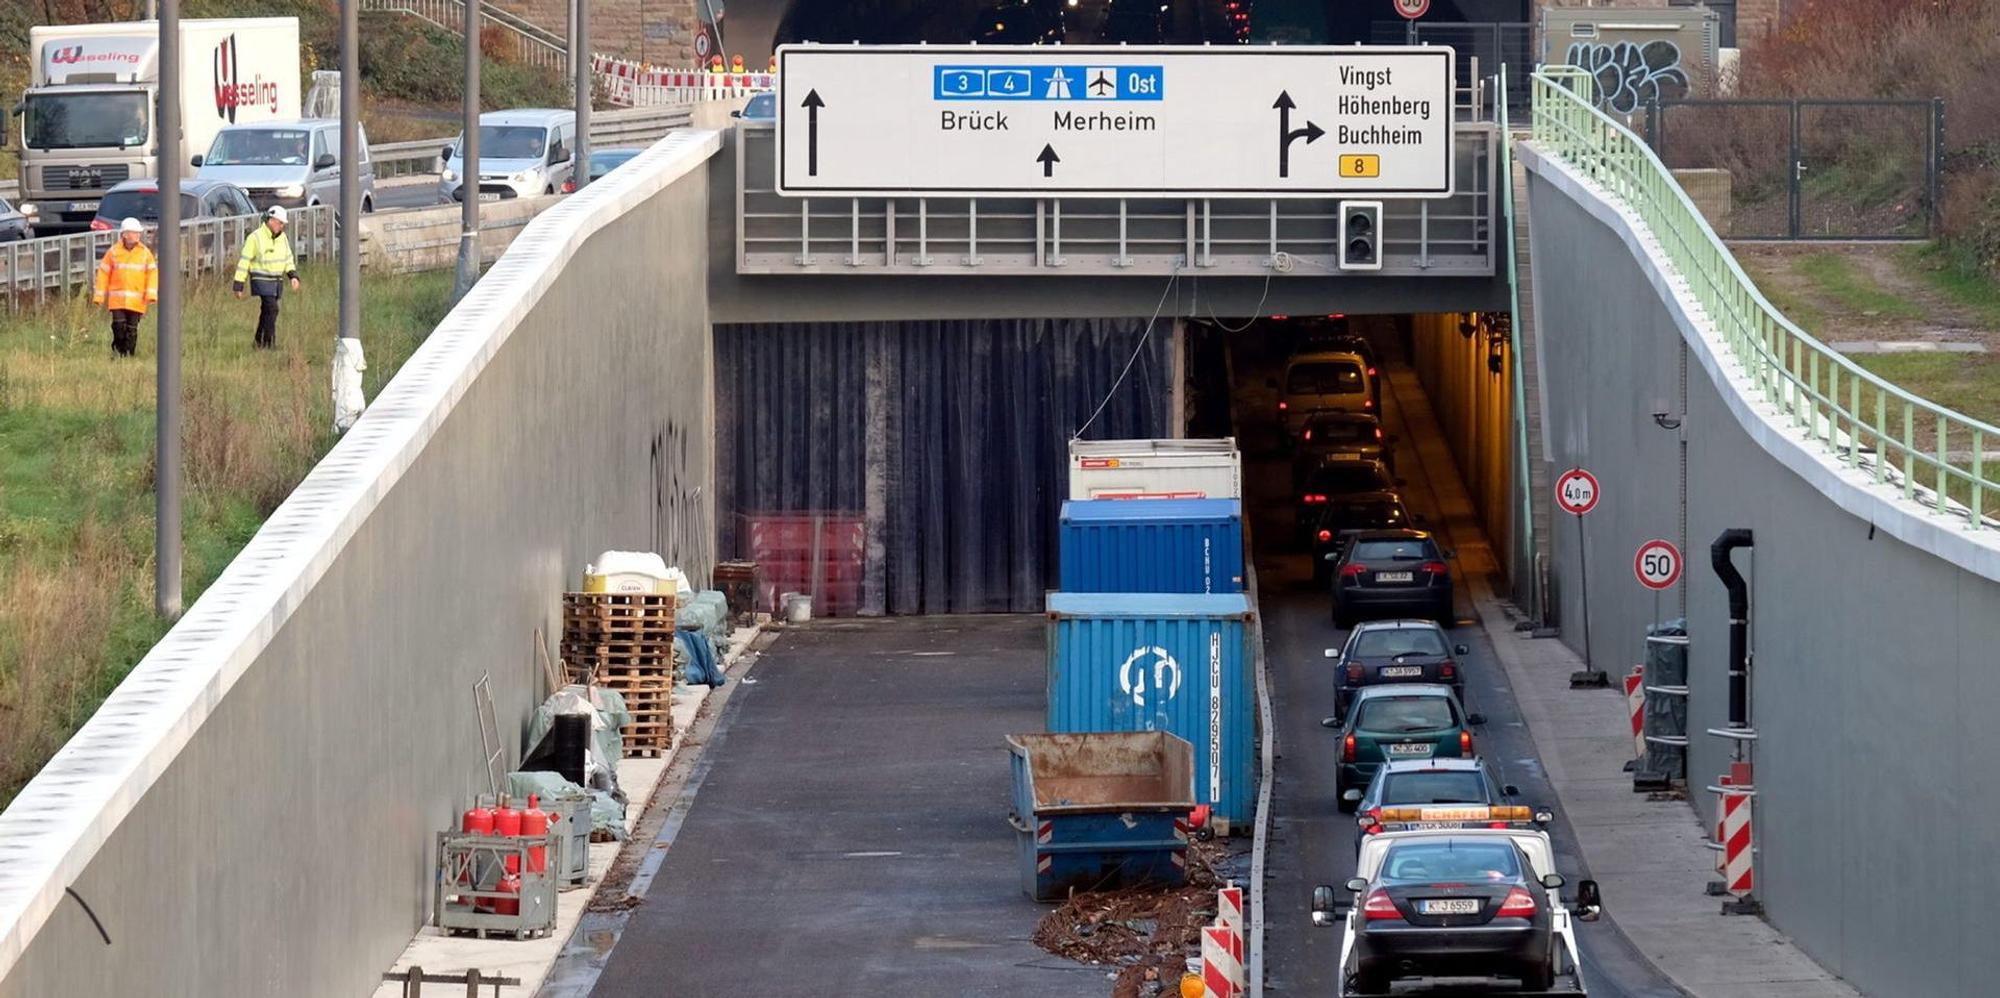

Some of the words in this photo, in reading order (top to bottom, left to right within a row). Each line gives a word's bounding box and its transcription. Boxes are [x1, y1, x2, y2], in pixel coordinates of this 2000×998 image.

[958, 75, 968, 91] 3
[1004, 75, 1015, 91] 4
[1129, 73, 1156, 94] Ost
[1340, 65, 1392, 91] Vingst
[1339, 95, 1430, 120] Höhenberg
[941, 110, 1009, 130] Brück
[1054, 110, 1156, 130] Merheim
[1339, 125, 1422, 145] Buchheim
[69, 169, 101, 177] MAN
[1354, 158, 1364, 174] 8
[1645, 555, 1670, 576] 50
[1450, 901, 1474, 911] 6559
